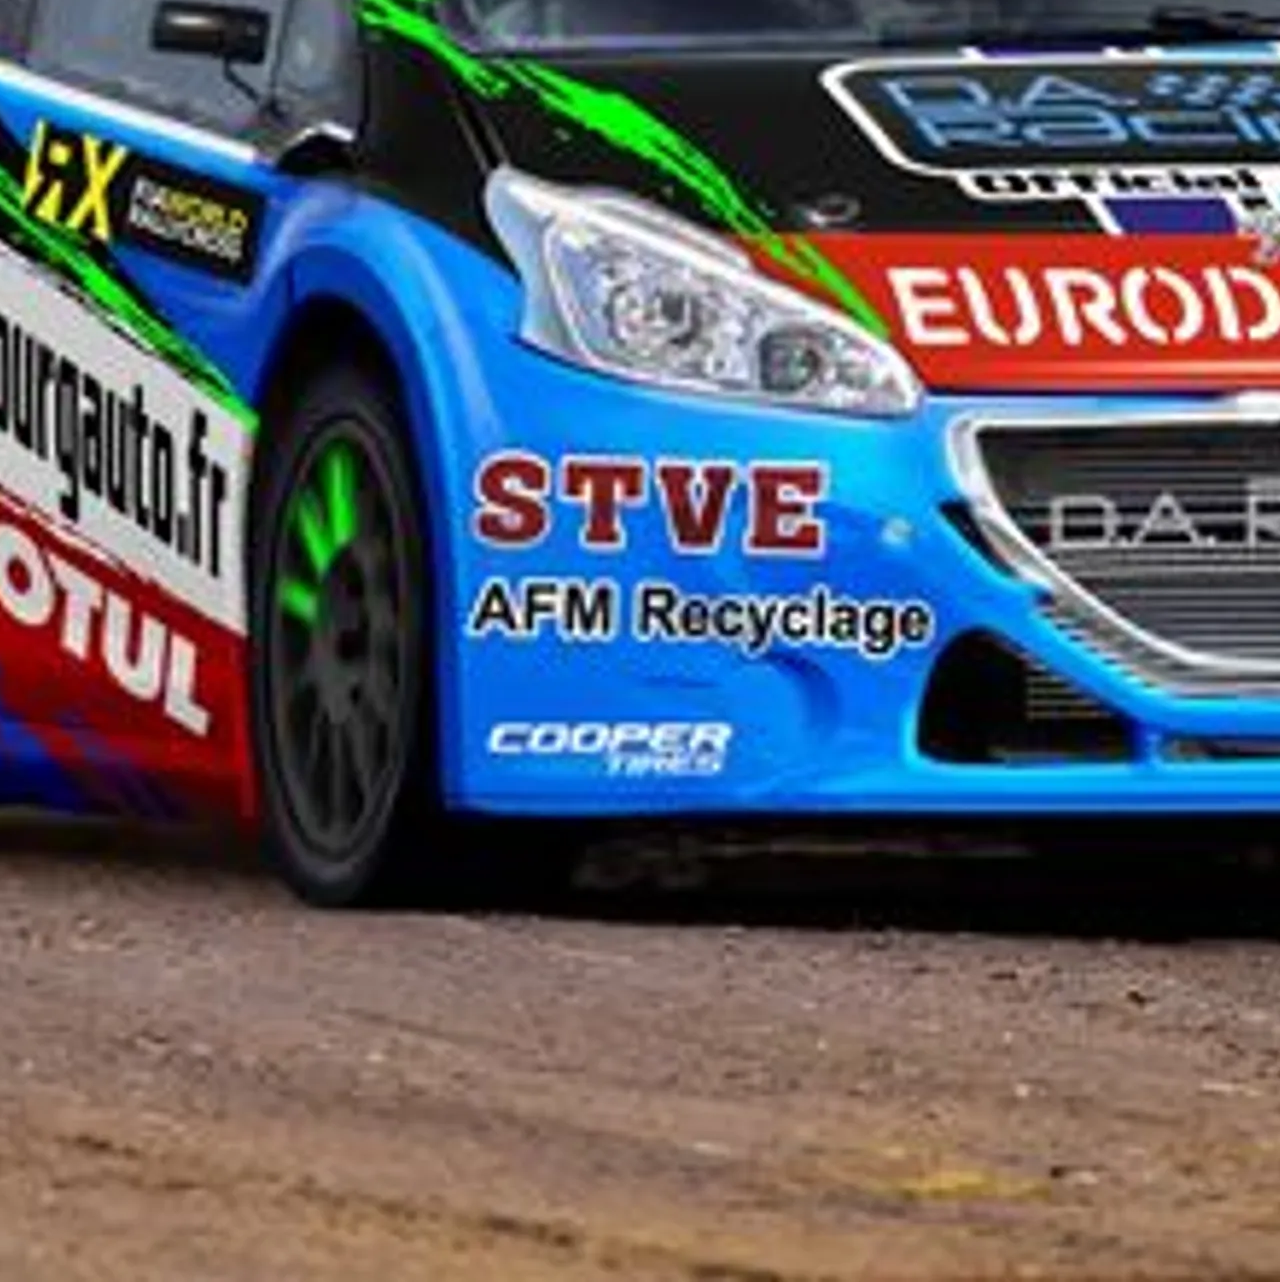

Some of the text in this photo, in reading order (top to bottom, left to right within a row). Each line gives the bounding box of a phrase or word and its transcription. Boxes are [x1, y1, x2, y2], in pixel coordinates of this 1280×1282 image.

[474, 452, 827, 554] STVE
[471, 580, 933, 658] AFM Recyclage
[489, 722, 732, 754] COOPER
